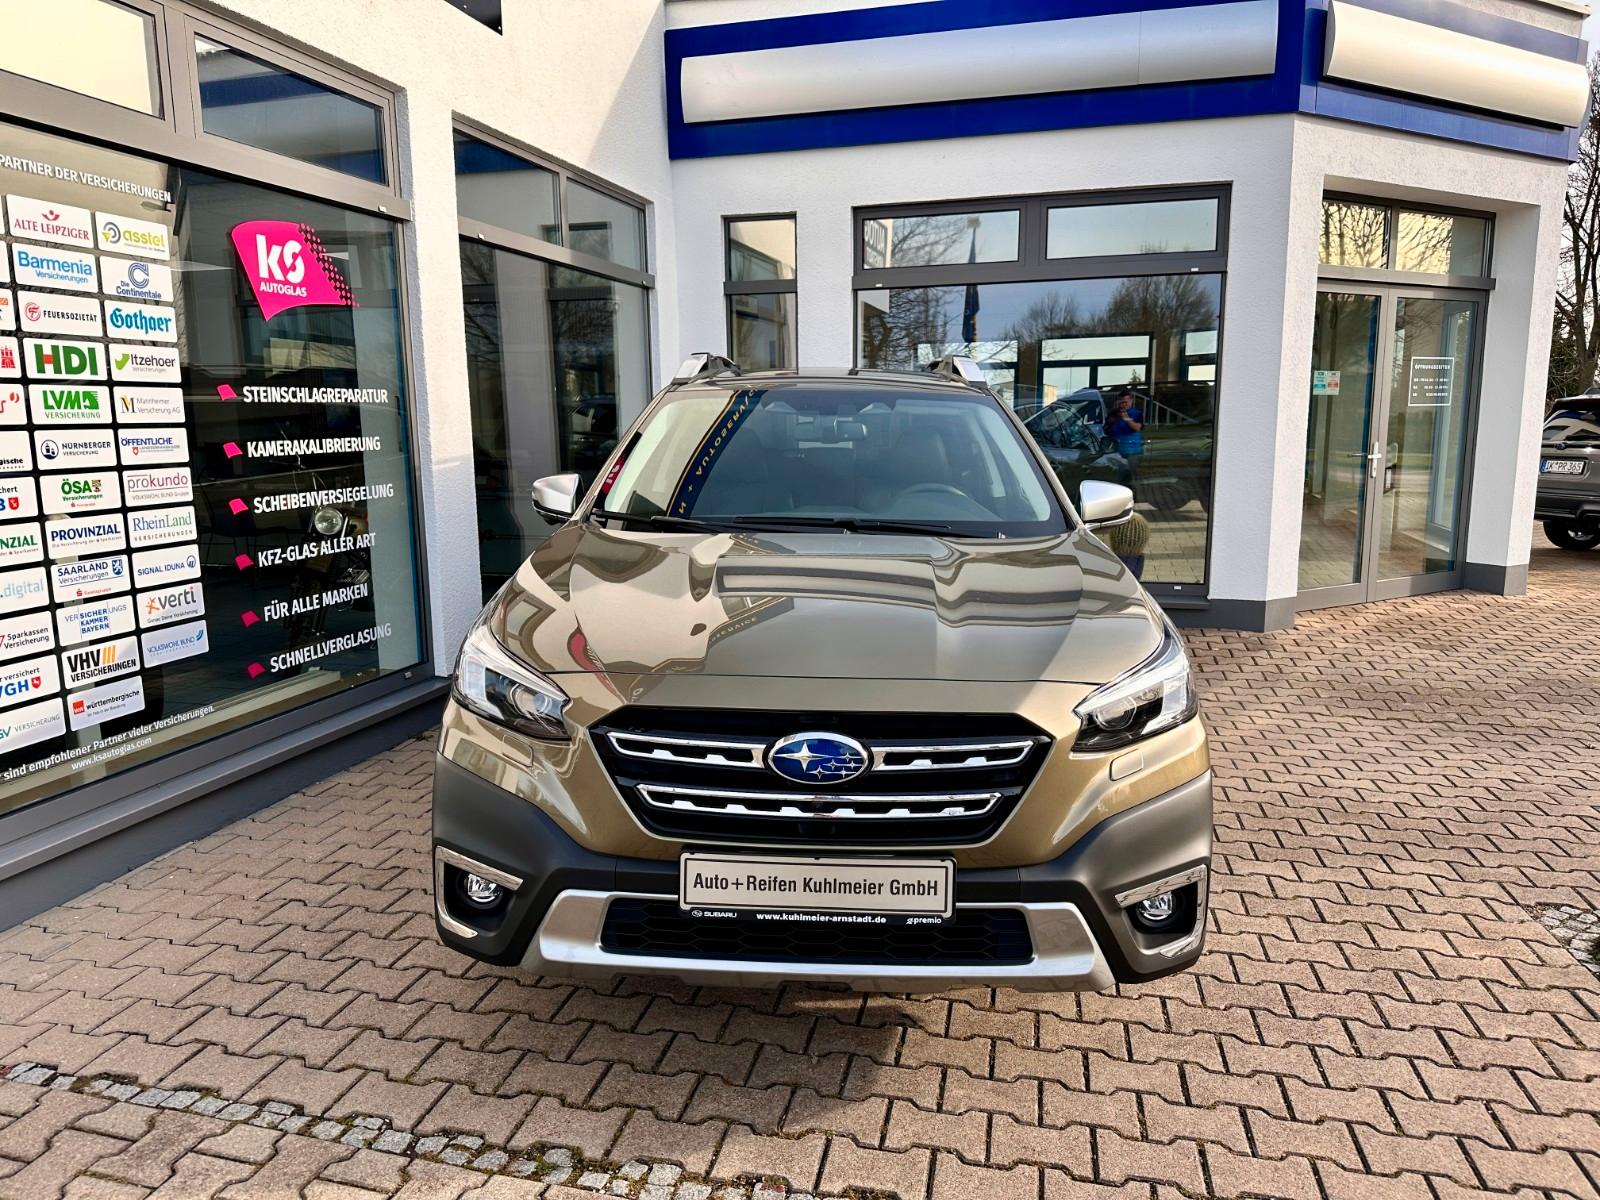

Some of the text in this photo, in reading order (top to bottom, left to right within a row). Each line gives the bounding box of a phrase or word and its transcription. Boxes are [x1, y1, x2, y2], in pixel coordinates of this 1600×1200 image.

[0, 153, 171, 202] PARTNER DER VERSICHERUNGEN
[14, 219, 90, 241] ALTE LEIPZIGER
[122, 230, 165, 247] asstel
[17, 251, 93, 276] Barmenia
[35, 269, 89, 284] Versicherungen
[115, 286, 162, 299] Continentale
[259, 281, 307, 298] AUTOGLAS
[43, 309, 97, 322] FEUERSOZIETÄT
[109, 307, 172, 335] Gothaer
[33, 343, 98, 376] HDI
[130, 353, 176, 368] Itzehoer
[42, 390, 84, 410] LVM
[242, 385, 388, 403] STEINSCHLAGREPARATUR
[44, 411, 101, 419] VERSICHERUNG
[137, 406, 171, 415] Versicherung
[62, 439, 111, 449] NÜRNBERGER
[121, 437, 173, 447] ÖFFENTLICHE
[247, 436, 381, 458] KAMERAKALIBRIERUNG
[61, 478, 92, 494] ÖSA
[127, 473, 188, 492] prokundo
[62, 493, 103, 502] Versicherungen
[253, 483, 394, 514] SCHEIBENVERSIEGELUNG
[132, 511, 192, 531] RheinLand
[51, 523, 121, 541] PROVINZIAL
[134, 529, 193, 541] VERSICHERUNGEN
[0, 535, 38, 549] NZIAL
[257, 533, 376, 568] KFZ-GLAS ALLER ART
[57, 562, 109, 577] SAARLAND
[58, 571, 109, 585] Versicherungen
[137, 562, 186, 577] SIGNAL IDUNA
[158, 586, 197, 609] verti
[264, 583, 368, 622] FÜR ALLE MARKEN
[81, 616, 109, 626] KAMMER
[81, 622, 110, 634] BAYERN
[3, 634, 50, 649] Versicherung
[7, 626, 49, 641] Sparkassen
[269, 622, 392, 673] SCHNELLVERGLASUNG
[66, 648, 101, 673] VHV
[4, 666, 41, 681] versichert
[70, 658, 137, 683] VERSICHERUNGEN
[86, 690, 140, 710] württembergische
[15, 713, 61, 734] VERSICHERUNG
[3, 705, 215, 781] sind empfohlener Partner vieler Versicherungen.
[71, 737, 152, 771] www.ksautoglas.com
[802, 876, 884, 896] Kuhlmeier
[889, 879, 938, 897] GmbH
[756, 912, 887, 924] www.kuhlmeier-arnstadt.de
